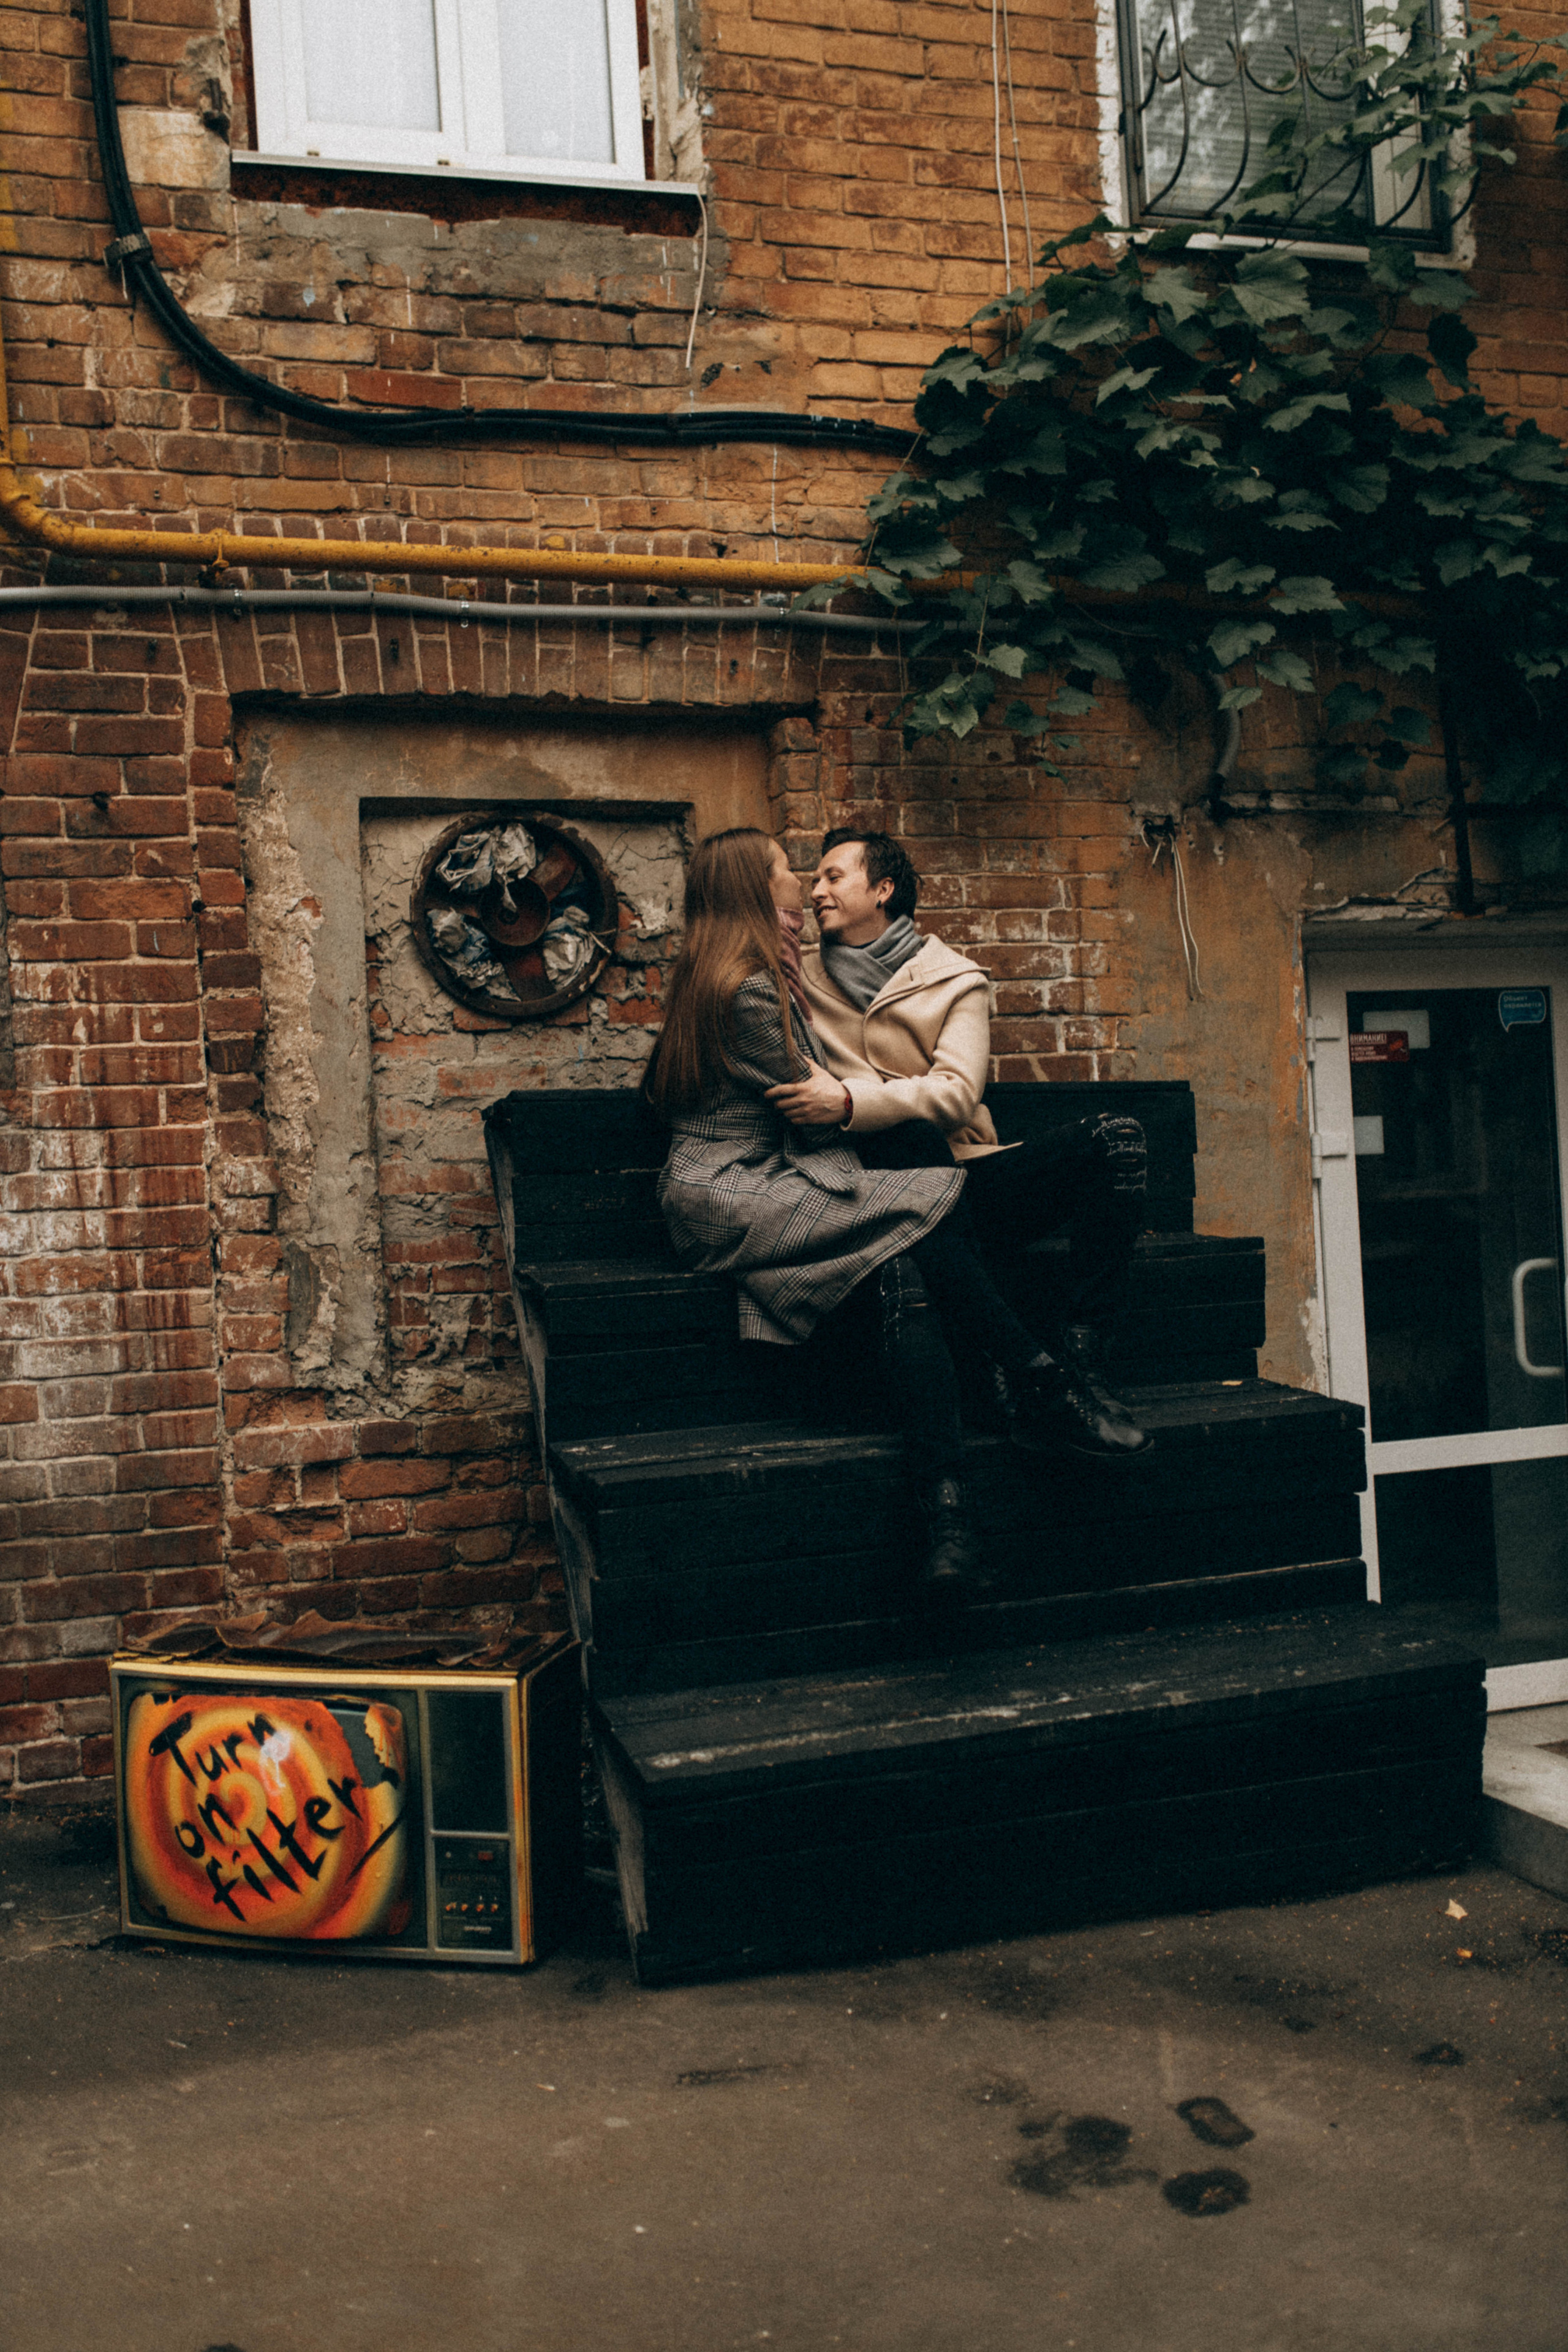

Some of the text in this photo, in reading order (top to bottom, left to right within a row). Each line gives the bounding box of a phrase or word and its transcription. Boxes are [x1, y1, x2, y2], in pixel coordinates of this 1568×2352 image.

[149, 1711, 284, 1787] Turn
[175, 1793, 240, 1858] on
[206, 1776, 364, 1923] filter
